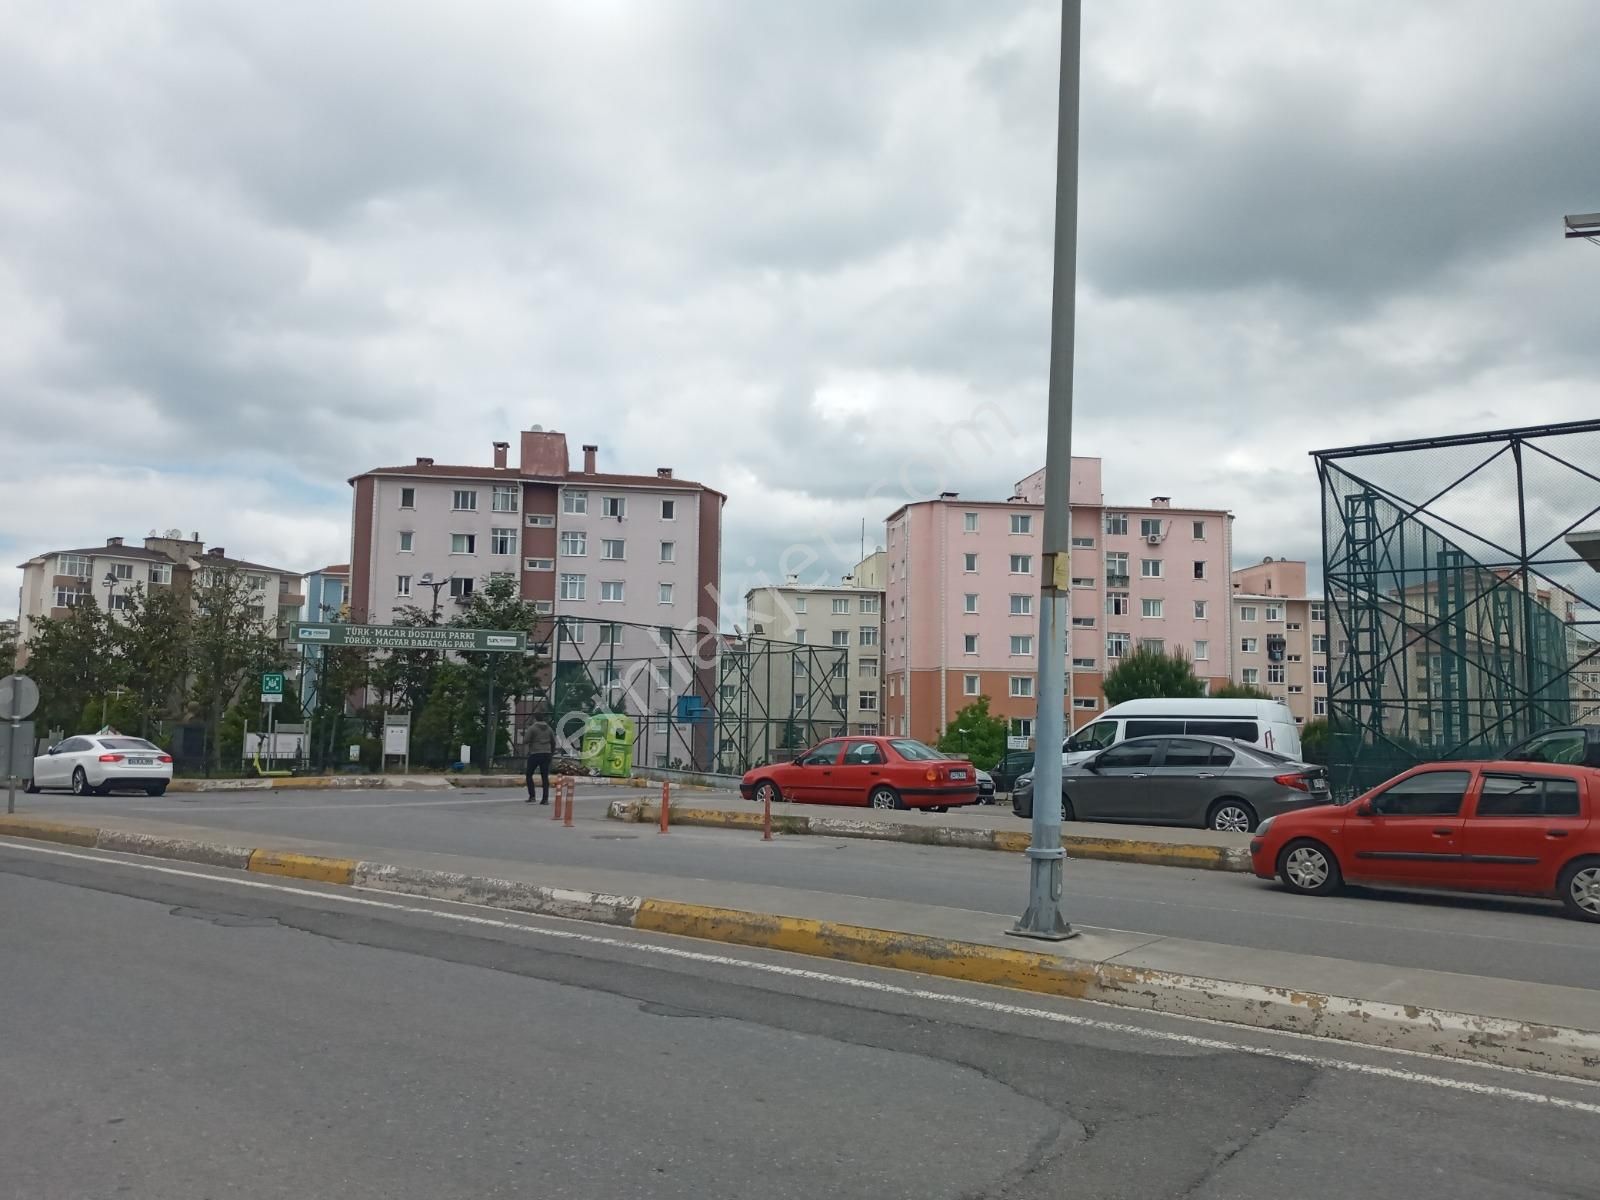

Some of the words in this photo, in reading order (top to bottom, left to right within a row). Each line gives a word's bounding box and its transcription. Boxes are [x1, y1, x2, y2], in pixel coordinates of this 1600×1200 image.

[408, 630, 448, 640] DOSTLUK
[449, 631, 475, 640] PARKI
[454, 640, 476, 649] PARK
